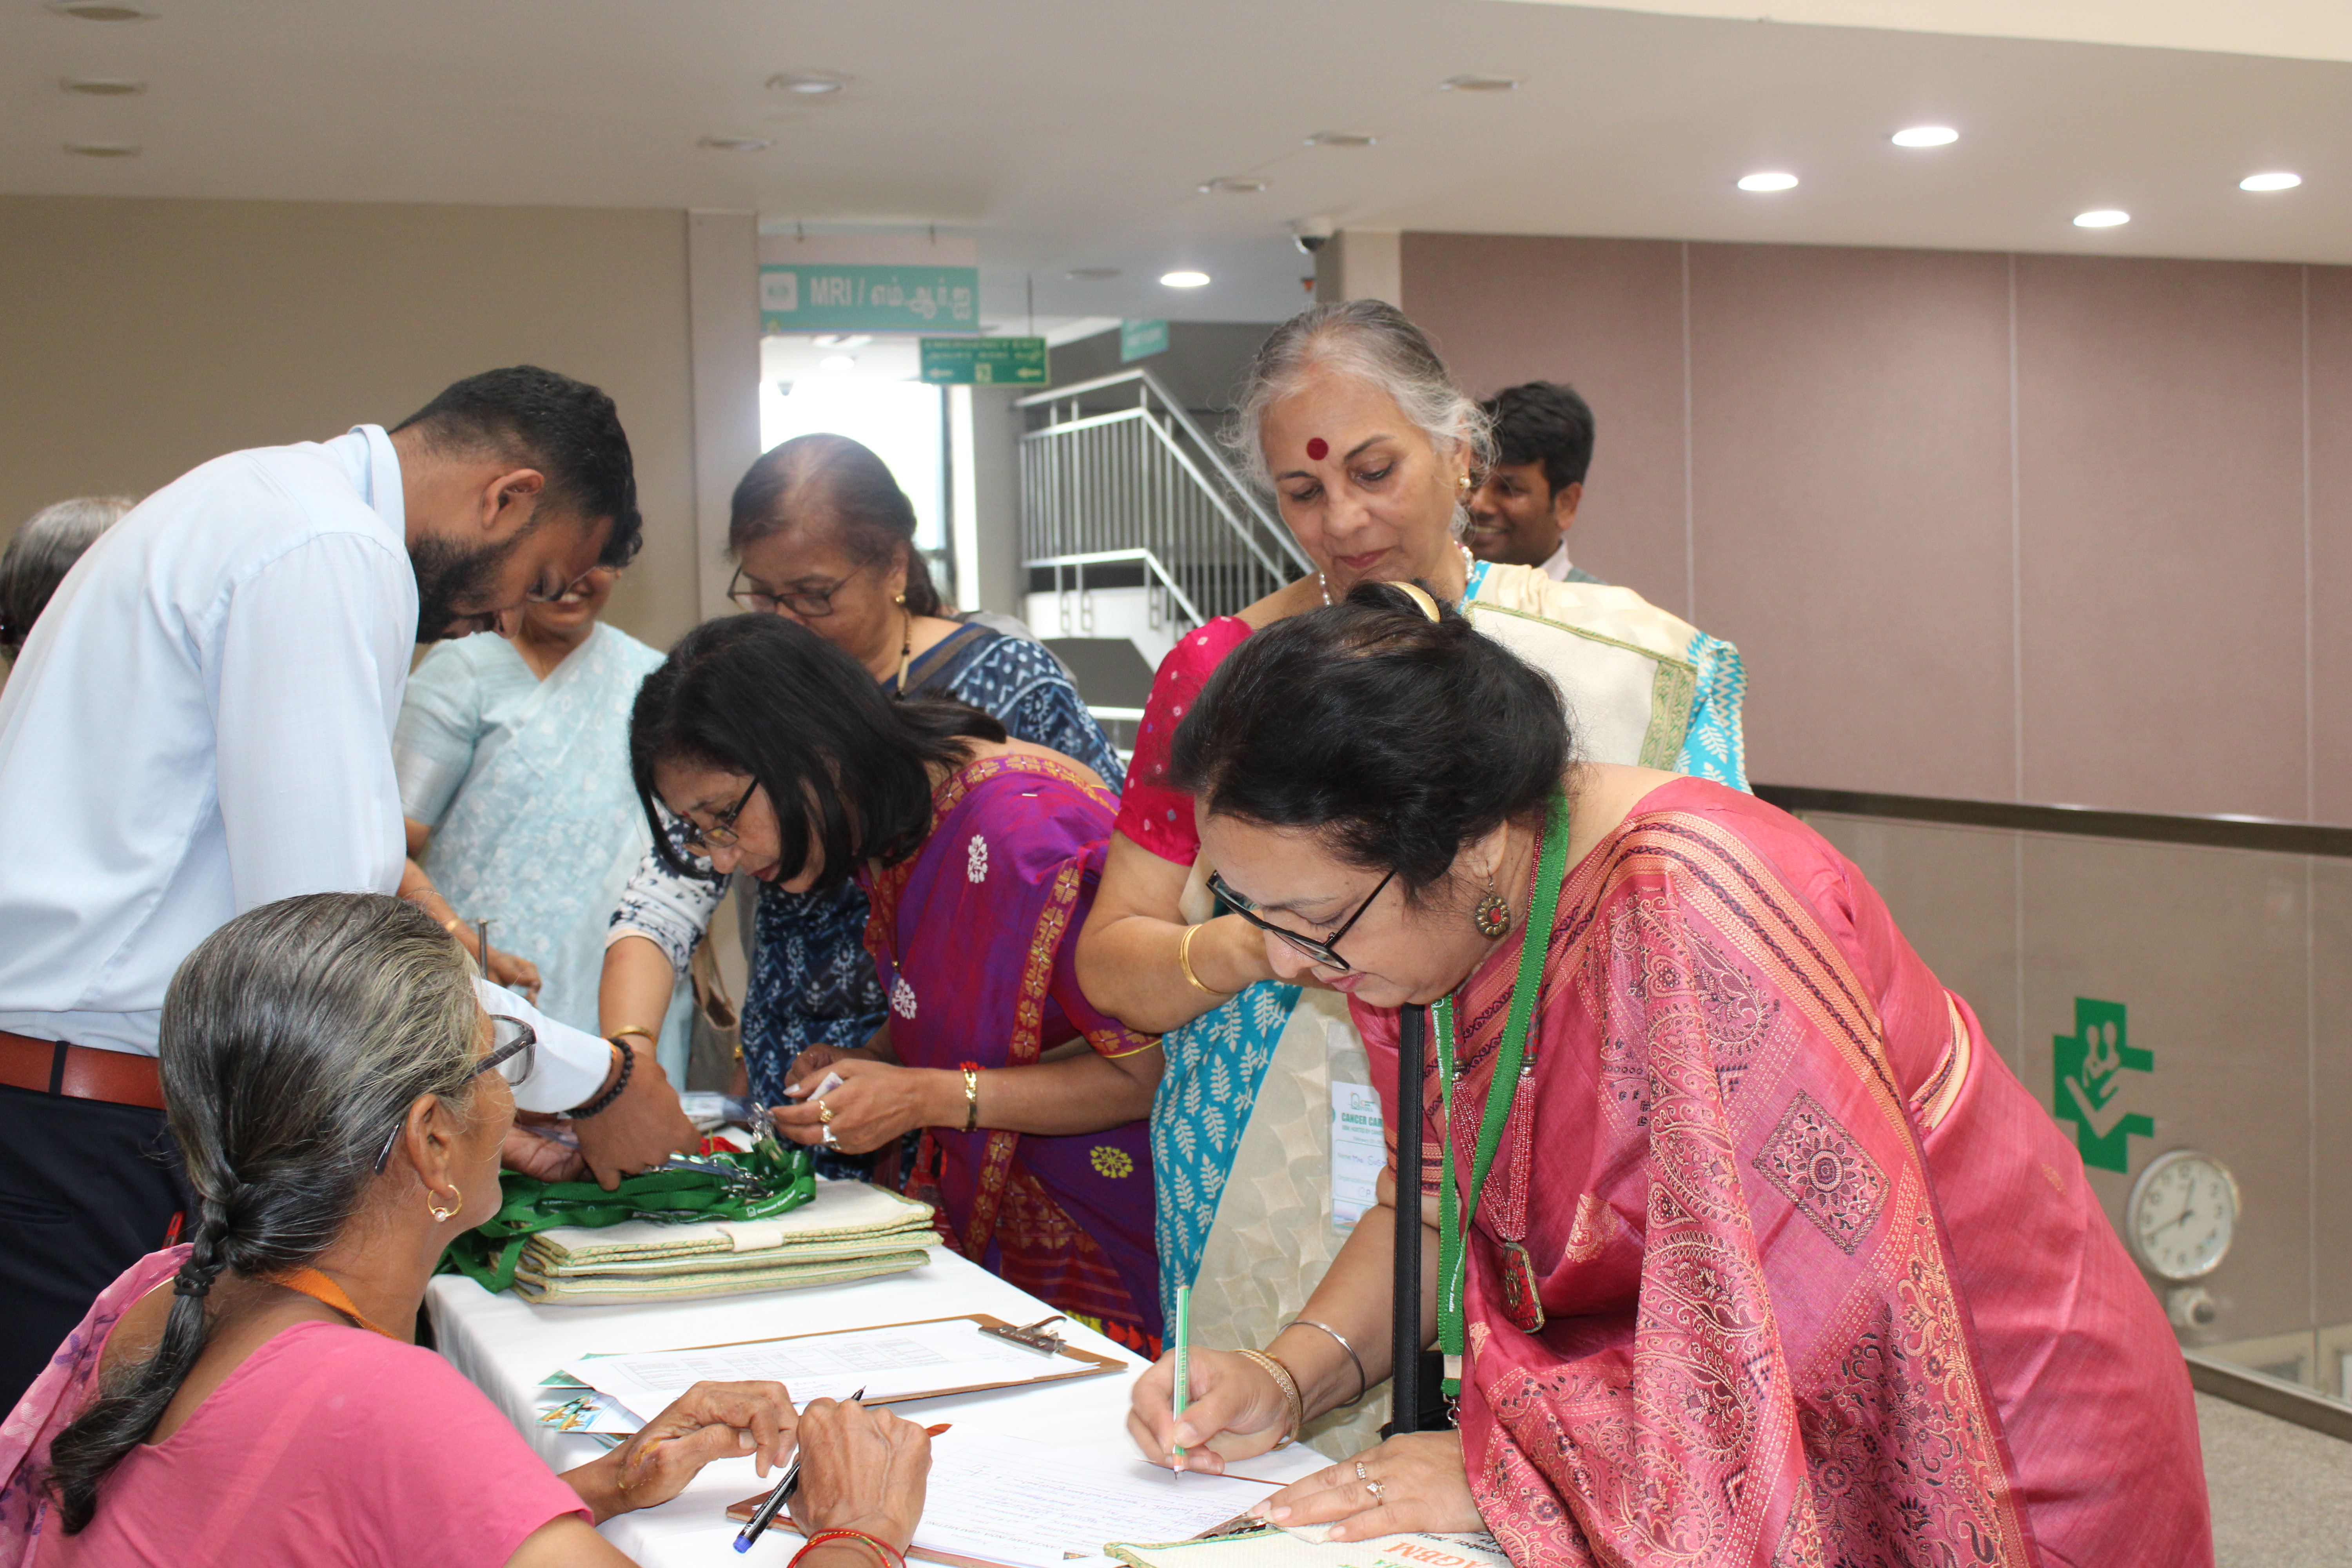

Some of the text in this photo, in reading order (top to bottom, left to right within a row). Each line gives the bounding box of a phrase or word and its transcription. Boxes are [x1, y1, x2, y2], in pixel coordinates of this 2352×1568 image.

[810, 277, 852, 306] MRI
[1342, 1112, 1383, 1127] CANCER CAR
[923, 1520, 959, 1530] MEETING
[1029, 1541, 1062, 1550] CANCER
